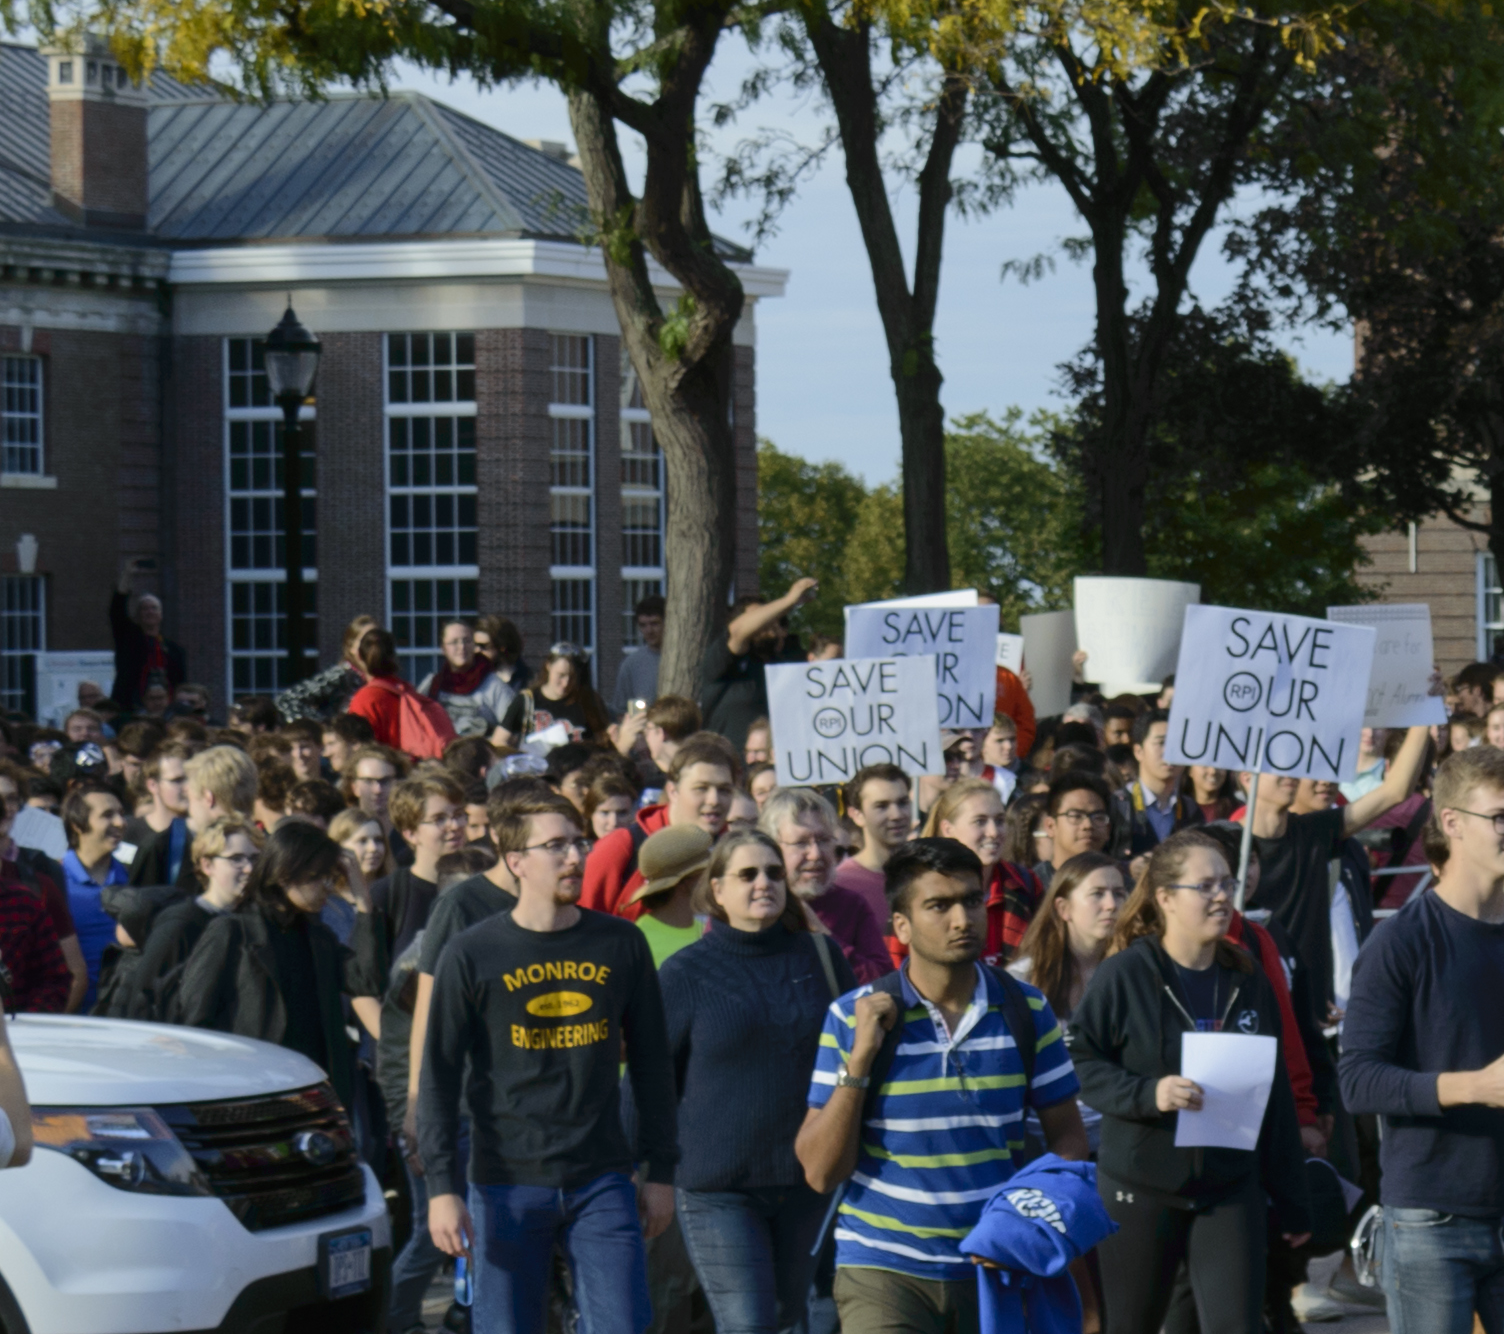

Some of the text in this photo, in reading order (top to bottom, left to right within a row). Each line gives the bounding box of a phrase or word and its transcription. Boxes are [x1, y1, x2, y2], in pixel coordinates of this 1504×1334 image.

[881, 611, 966, 645] SAVE
[1225, 617, 1334, 669] SAVE
[806, 661, 898, 699] SAVE
[1223, 671, 1317, 722] OUR
[1230, 683, 1256, 701] RPI
[813, 703, 897, 739] OUR
[818, 717, 842, 730] RPI
[787, 741, 928, 782] UNION
[1181, 718, 1345, 777] UNION
[502, 960, 611, 992] MONROE
[510, 1019, 609, 1050] ENGINEERING
